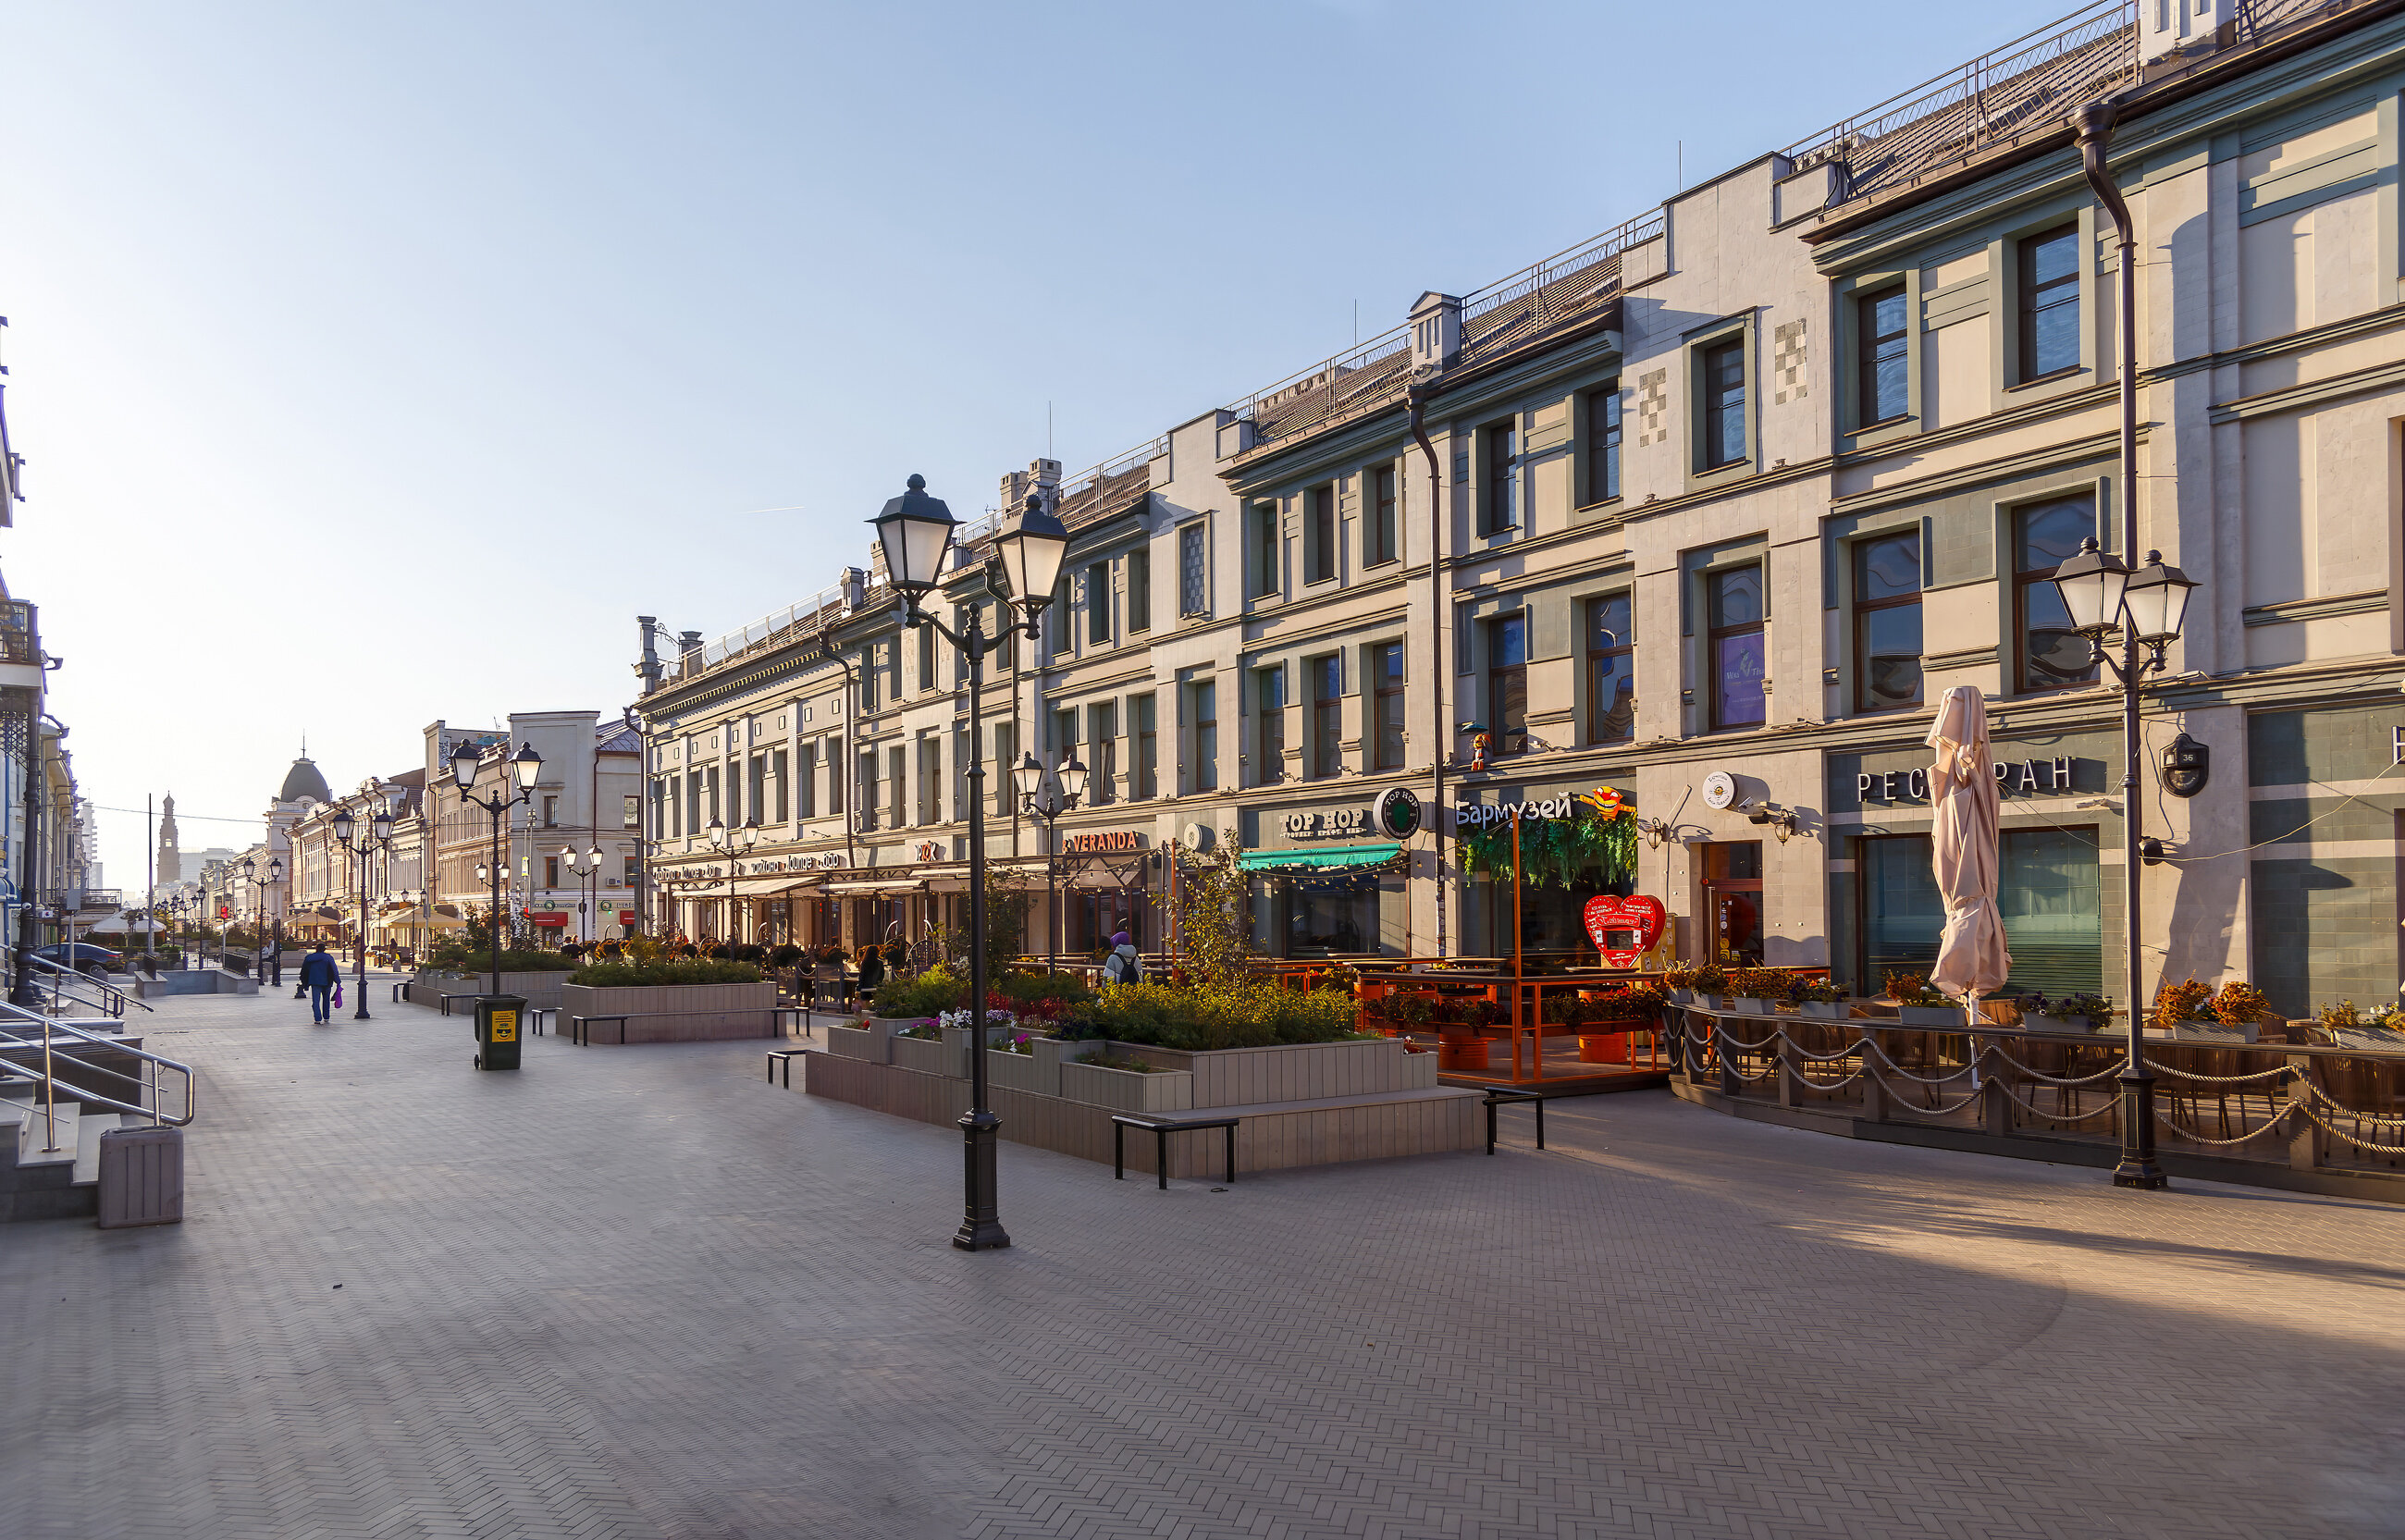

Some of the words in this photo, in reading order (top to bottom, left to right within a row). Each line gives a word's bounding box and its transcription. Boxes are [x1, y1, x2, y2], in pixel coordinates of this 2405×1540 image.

[1857, 756, 2071, 802] РЕСРАН
[1386, 791, 1400, 805] TOP
[1402, 792, 1418, 807] HOP
[1455, 791, 1572, 830] Бармузей
[1279, 813, 1314, 832] TOP
[1323, 808, 1363, 830] HOP
[1074, 832, 1137, 852] VERANDA
